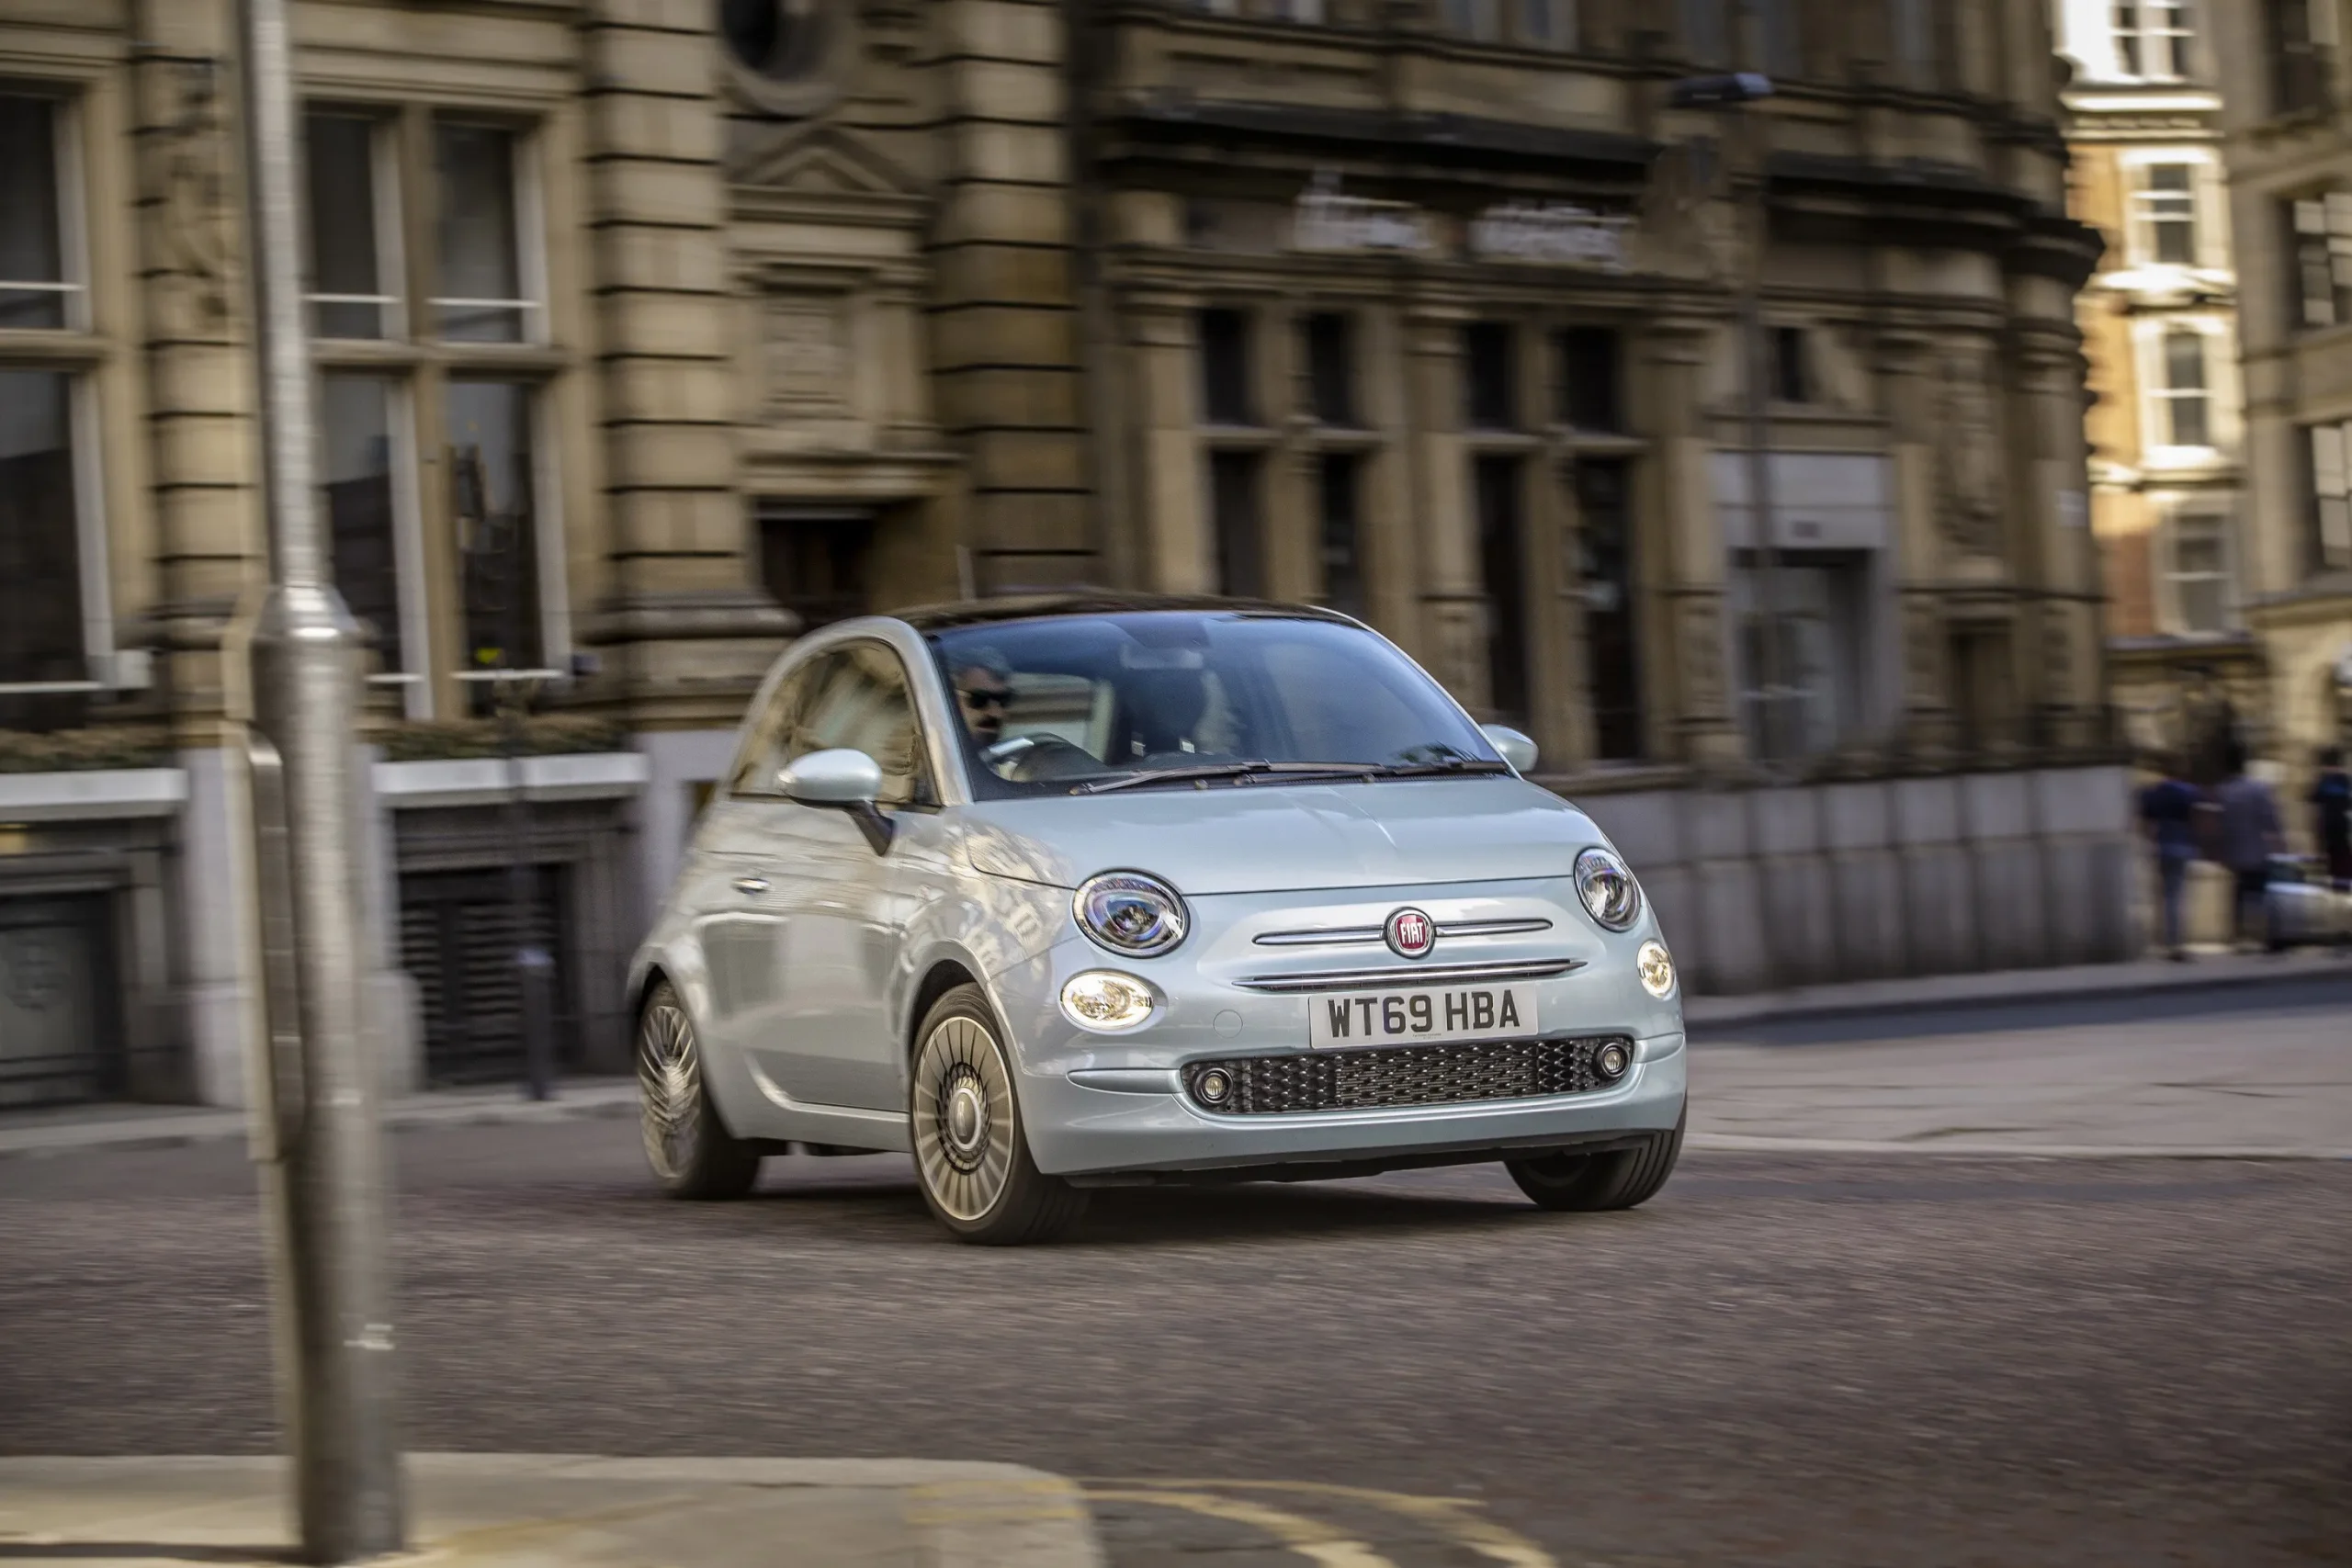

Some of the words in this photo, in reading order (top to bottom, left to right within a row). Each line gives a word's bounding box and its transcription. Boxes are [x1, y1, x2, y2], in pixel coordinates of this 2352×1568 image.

[1400, 922, 1423, 943] FIAT
[1328, 996, 1433, 1038] WT69
[1445, 989, 1521, 1032] HBA
